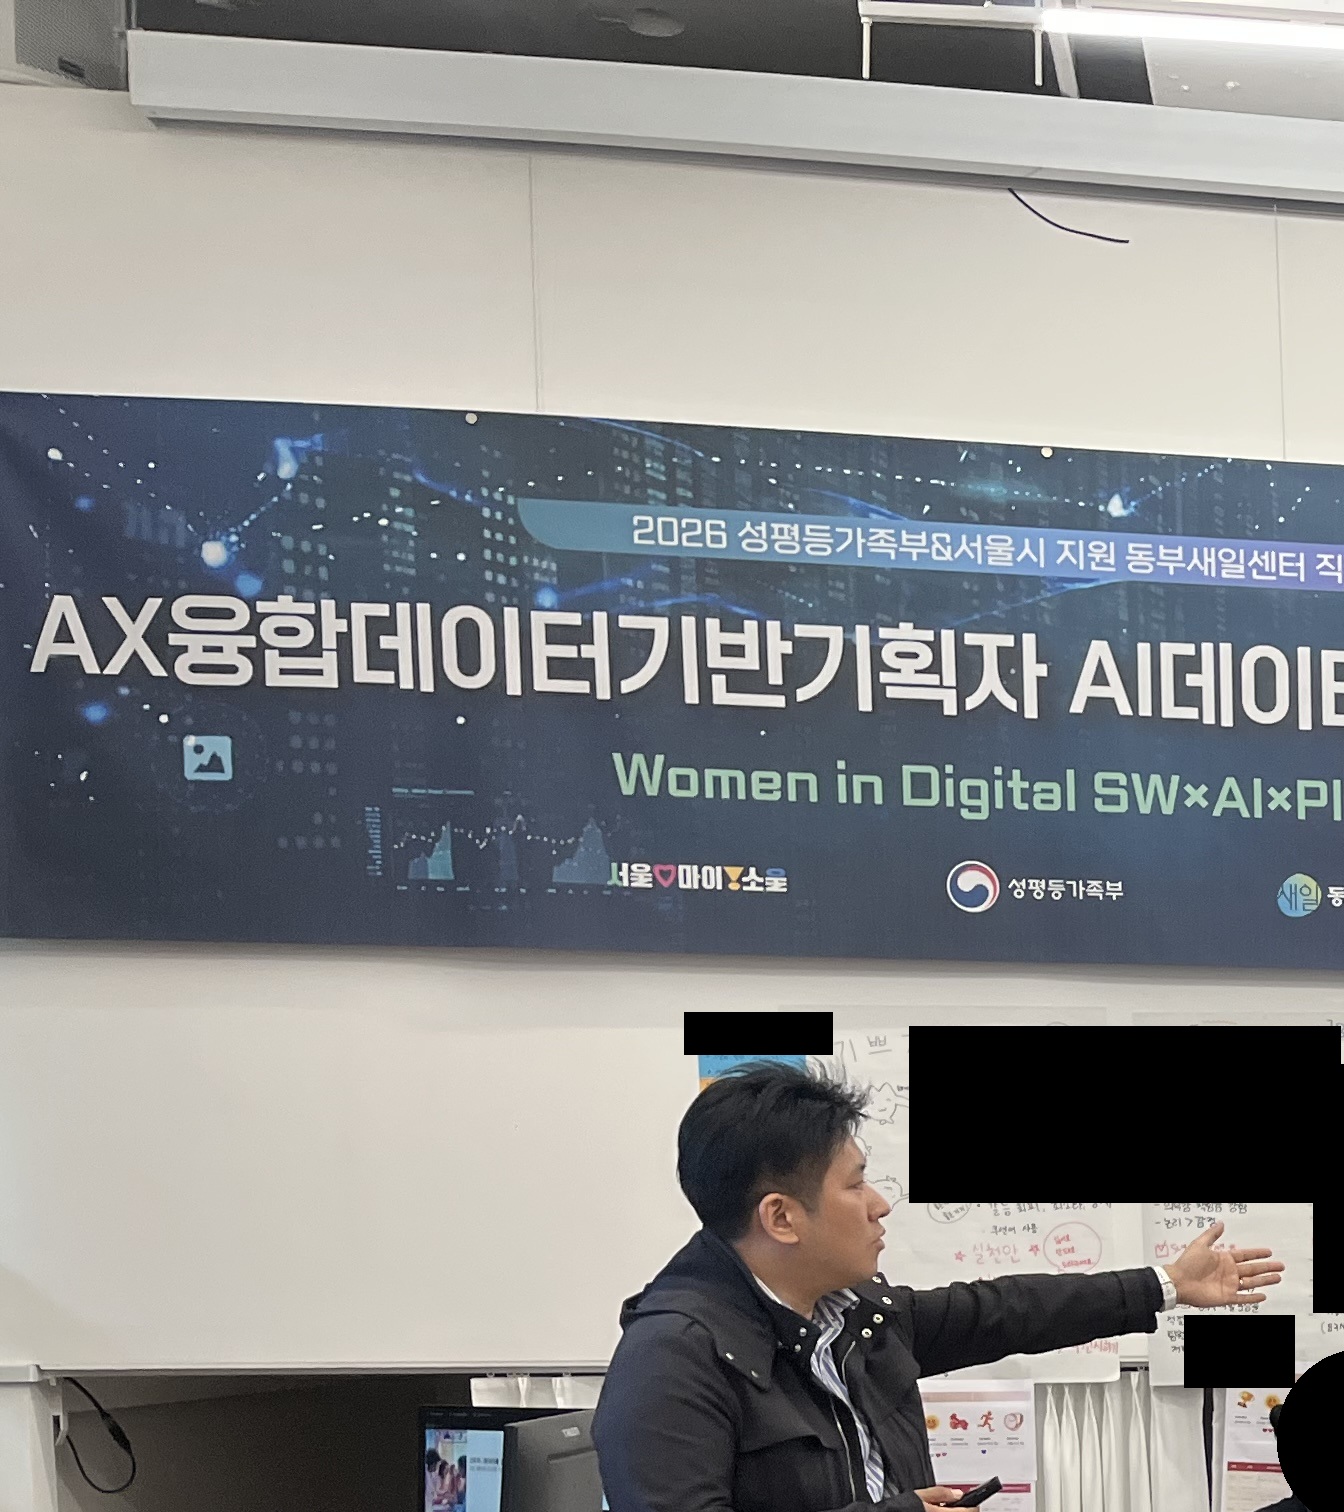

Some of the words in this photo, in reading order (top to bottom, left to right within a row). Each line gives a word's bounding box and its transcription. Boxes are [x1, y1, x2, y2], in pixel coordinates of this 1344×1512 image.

[631, 515, 729, 550] 2026
[739, 520, 1046, 569] 성평등가족부&서울시
[1056, 539, 1117, 572] 지원
[1125, 543, 1305, 582] 동부새일센터
[29, 593, 1048, 719] AX융합데이터기반기획자
[612, 751, 818, 803] Women
[835, 760, 885, 806] in
[902, 765, 1076, 821] Digital
[1007, 877, 1124, 900] 성평등가족부
[1280, 883, 1320, 913] 새일
